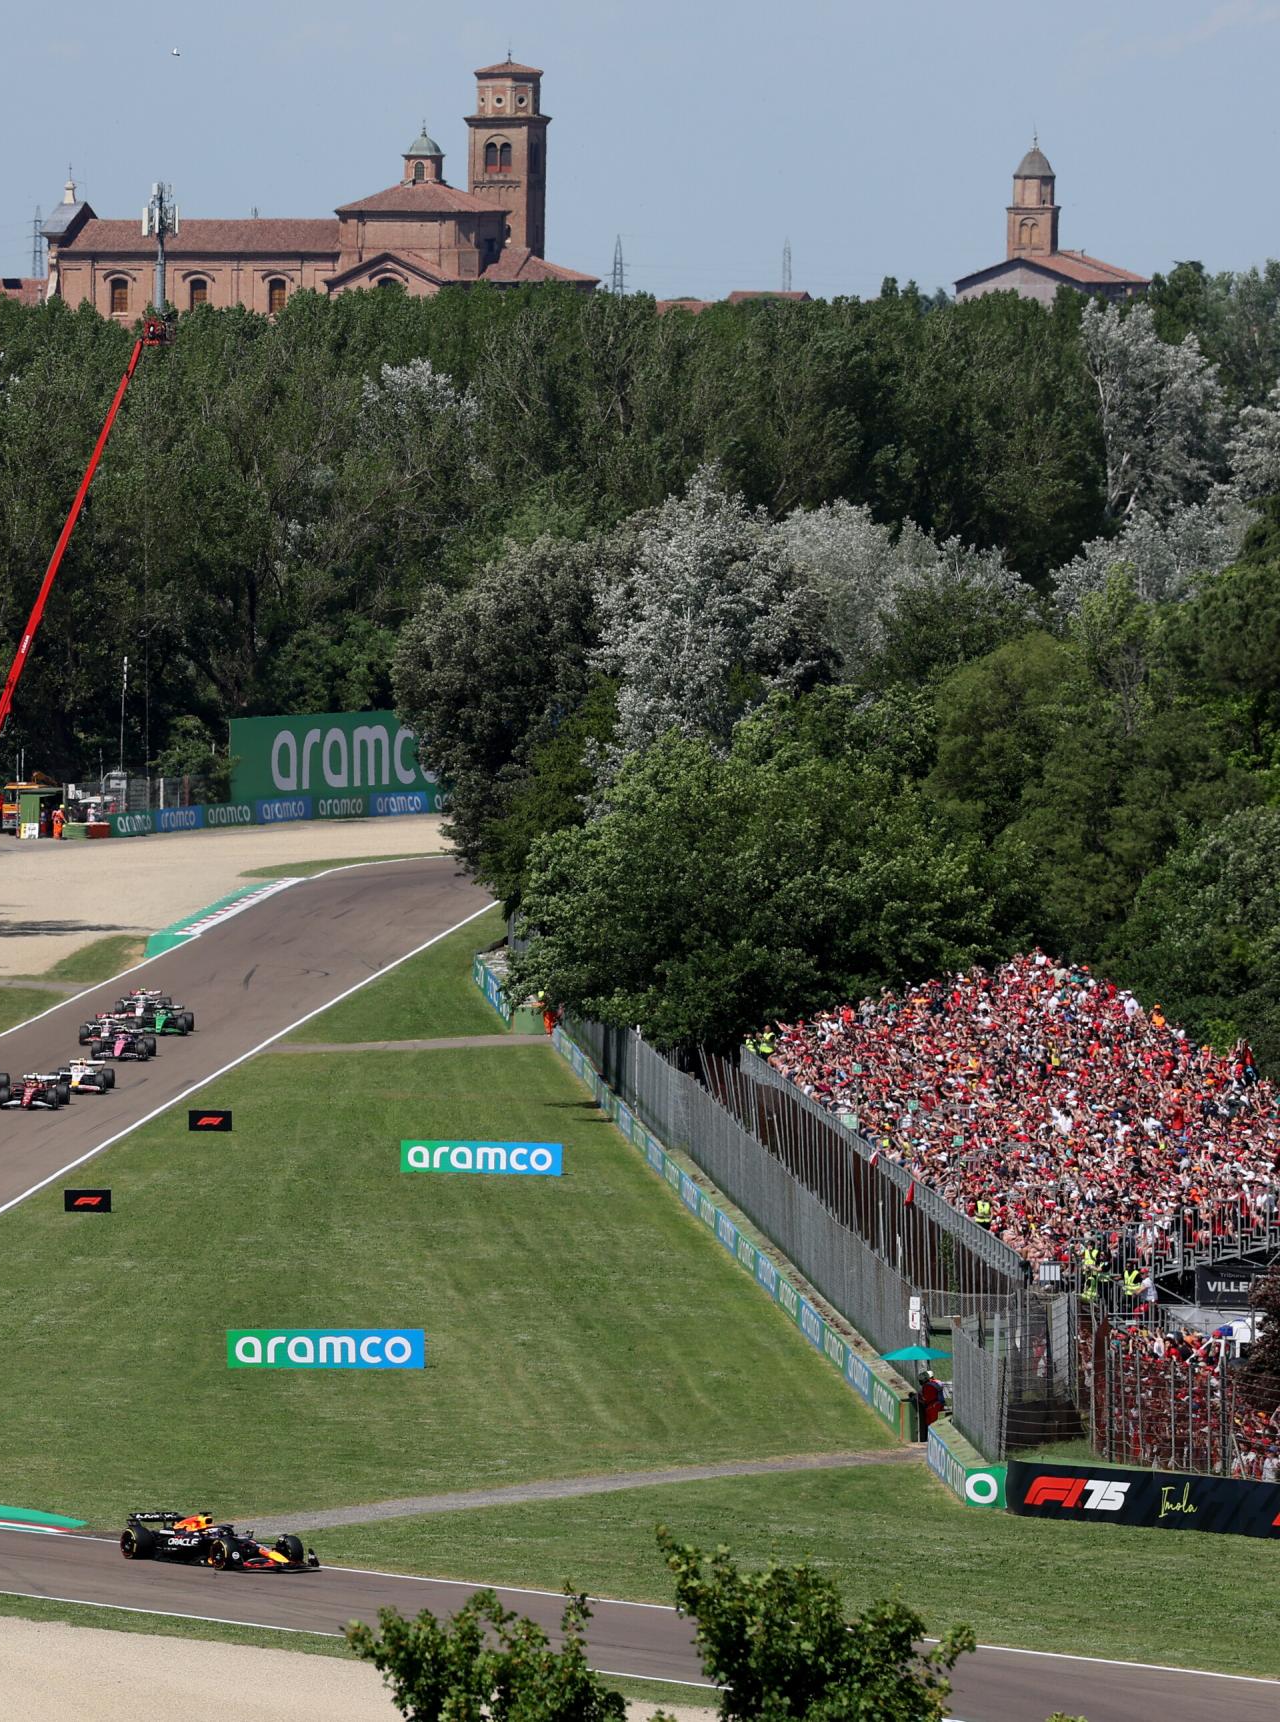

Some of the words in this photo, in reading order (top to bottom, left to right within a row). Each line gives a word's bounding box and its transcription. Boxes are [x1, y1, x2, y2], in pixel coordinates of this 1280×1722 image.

[271, 724, 438, 791] aramc
[208, 804, 251, 824] aramco
[263, 801, 305, 820] aramco
[319, 798, 363, 815] aramco
[377, 795, 421, 814] aramco
[161, 811, 196, 828] aramco
[407, 1146, 553, 1171] aramco
[1207, 1281, 1252, 1292] VILLE
[235, 1336, 412, 1364] aramco
[167, 1537, 200, 1547] ORACLE
